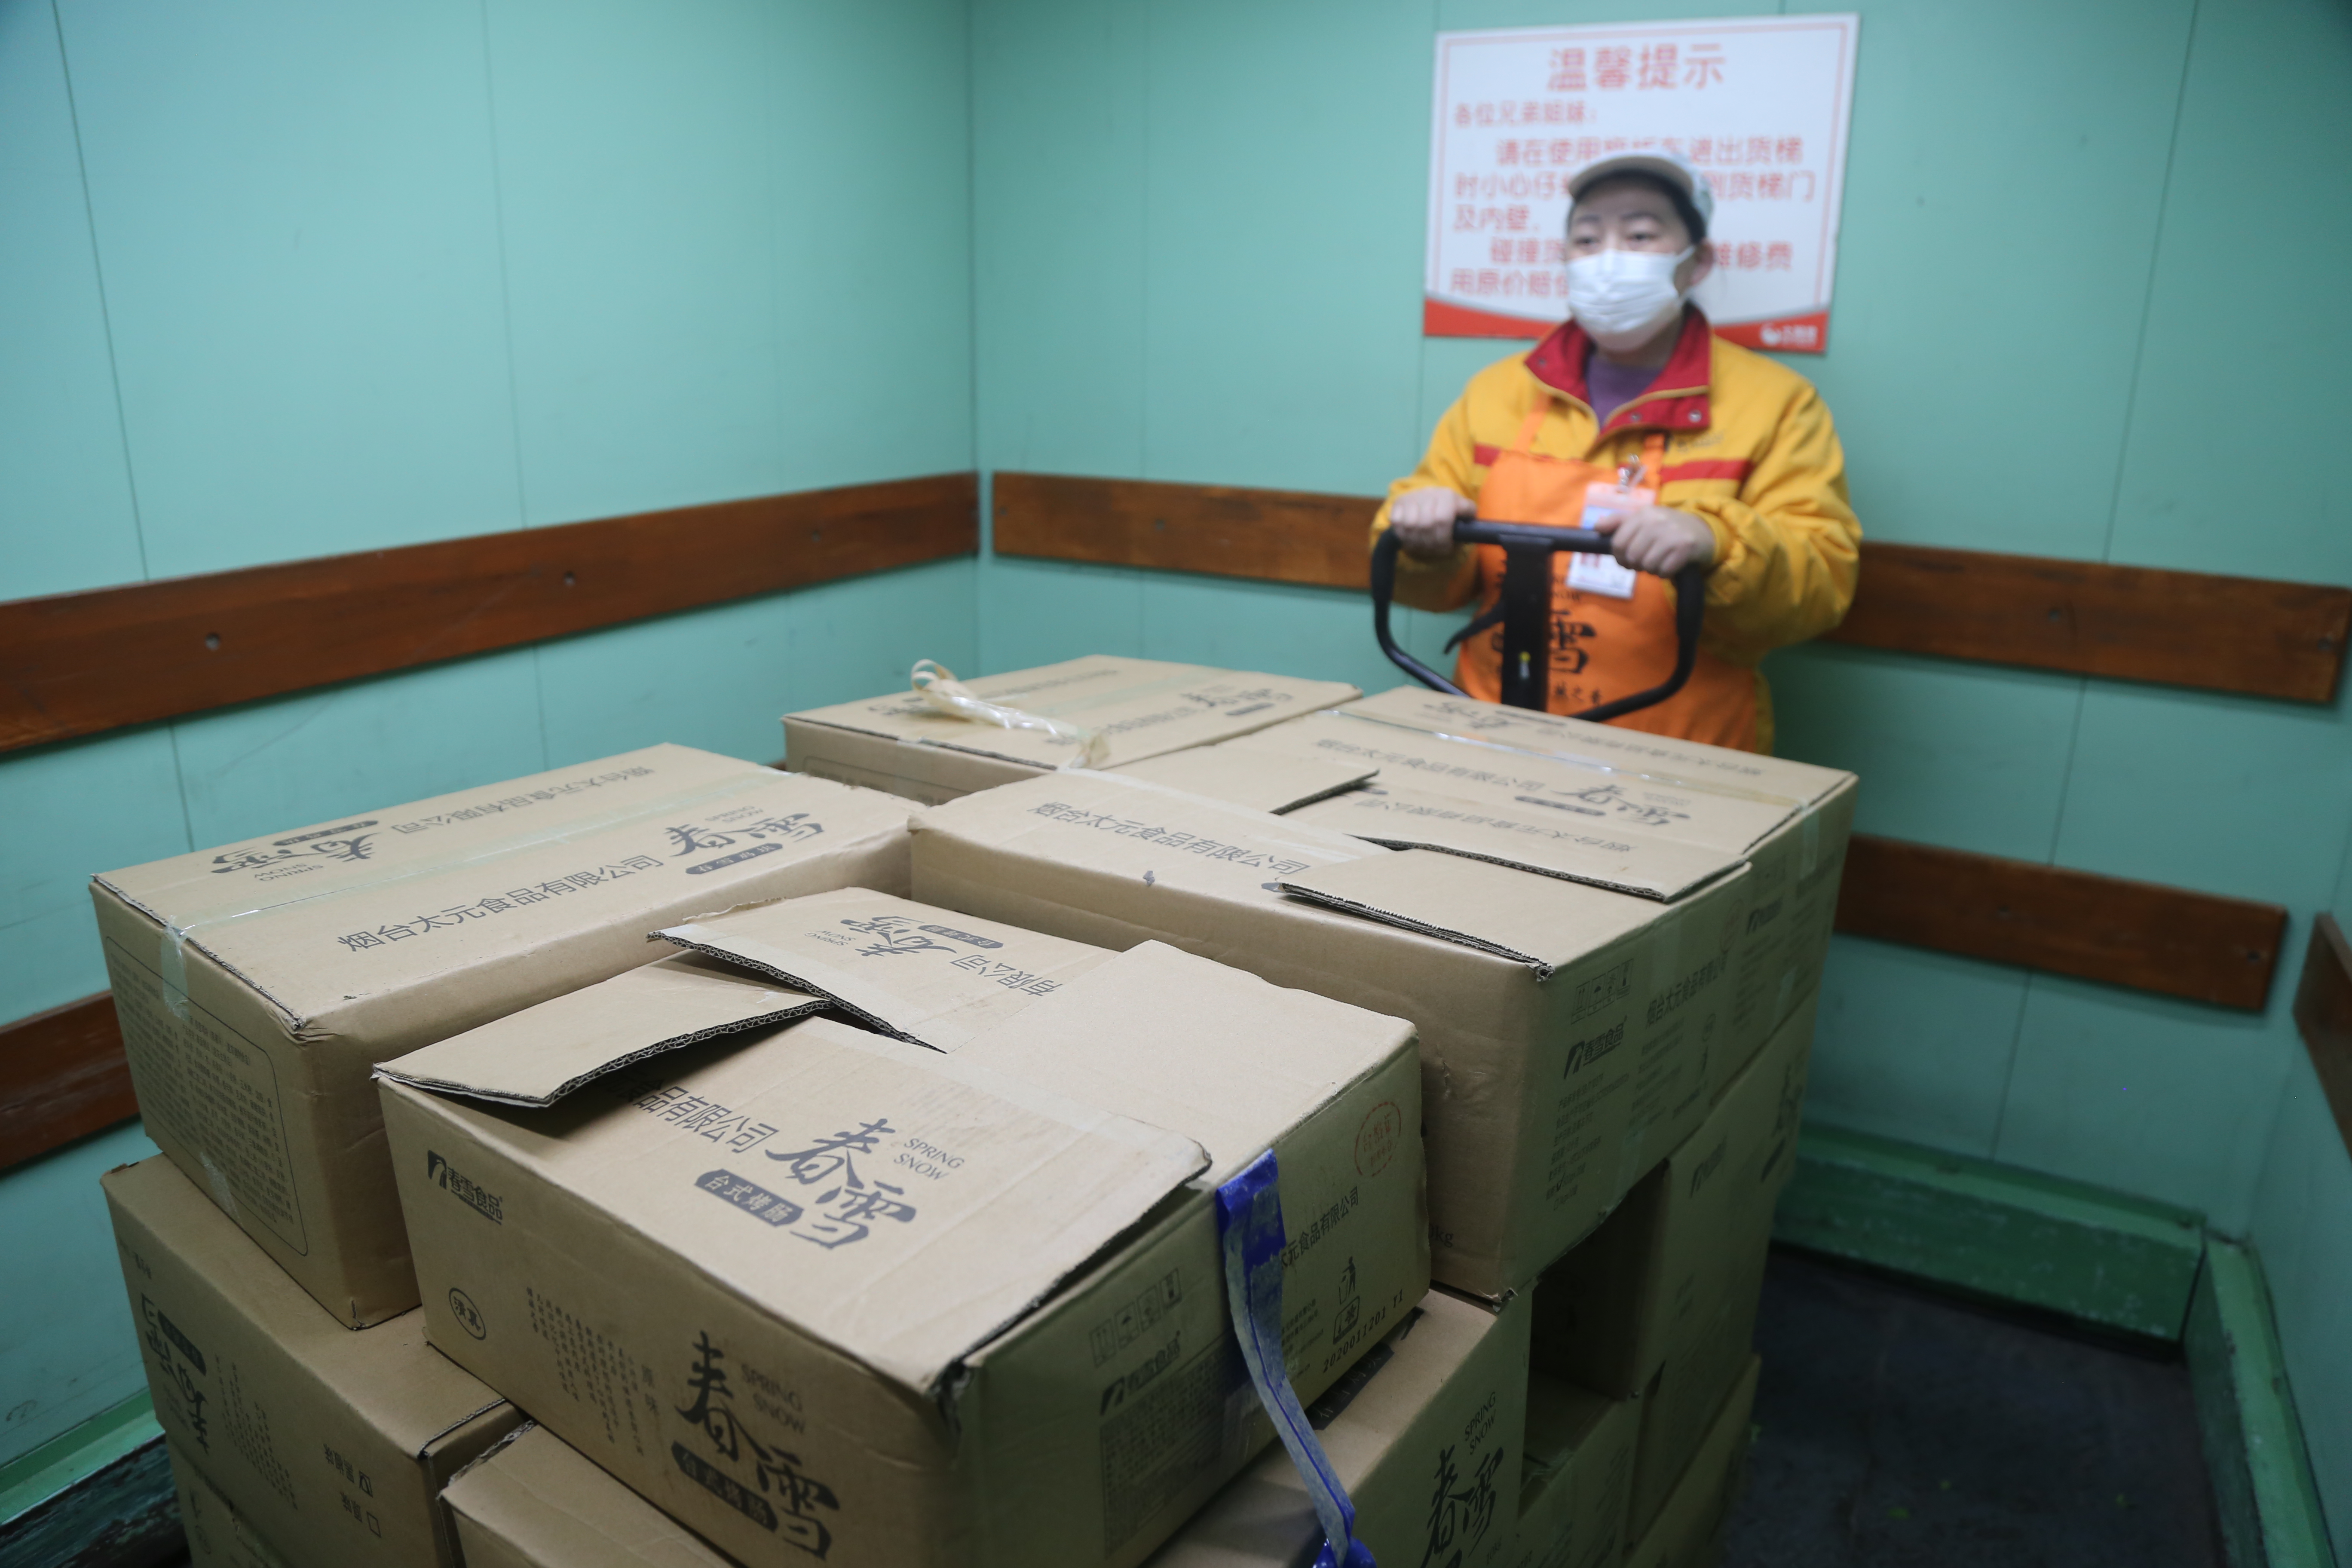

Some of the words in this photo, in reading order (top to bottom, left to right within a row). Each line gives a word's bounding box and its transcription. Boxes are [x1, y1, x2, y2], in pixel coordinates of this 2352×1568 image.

[1547, 43, 1725, 93] 温馨提示
[1496, 135, 1804, 167] 请在使用进出货梯
[392, 766, 654, 833] 烟台太元食品有限公司
[1027, 801, 1311, 875] 烟台太元食品有限公司
[254, 863, 308, 879] SNOW
[259, 864, 324, 882] SPRING
[336, 854, 664, 952] 烟台太元食品有限公司
[804, 931, 848, 947] SPRING
[817, 929, 856, 943] SNOW
[949, 954, 1063, 997] 有限公司
[893, 1153, 951, 1182] SNOW
[903, 1137, 965, 1170] SPRING
[447, 1166, 503, 1221] 春雪食品
[704, 1175, 793, 1223] 台式烤肠
[765, 1118, 917, 1250] 春雪
[1323, 1305, 1386, 1374] 2020011201
[741, 1363, 804, 1413] SPRING
[752, 1392, 807, 1436] SNOW
[1464, 1391, 1496, 1442] SPRING
[1469, 1409, 1497, 1455] SNOW
[675, 1330, 840, 1562] 春雪
